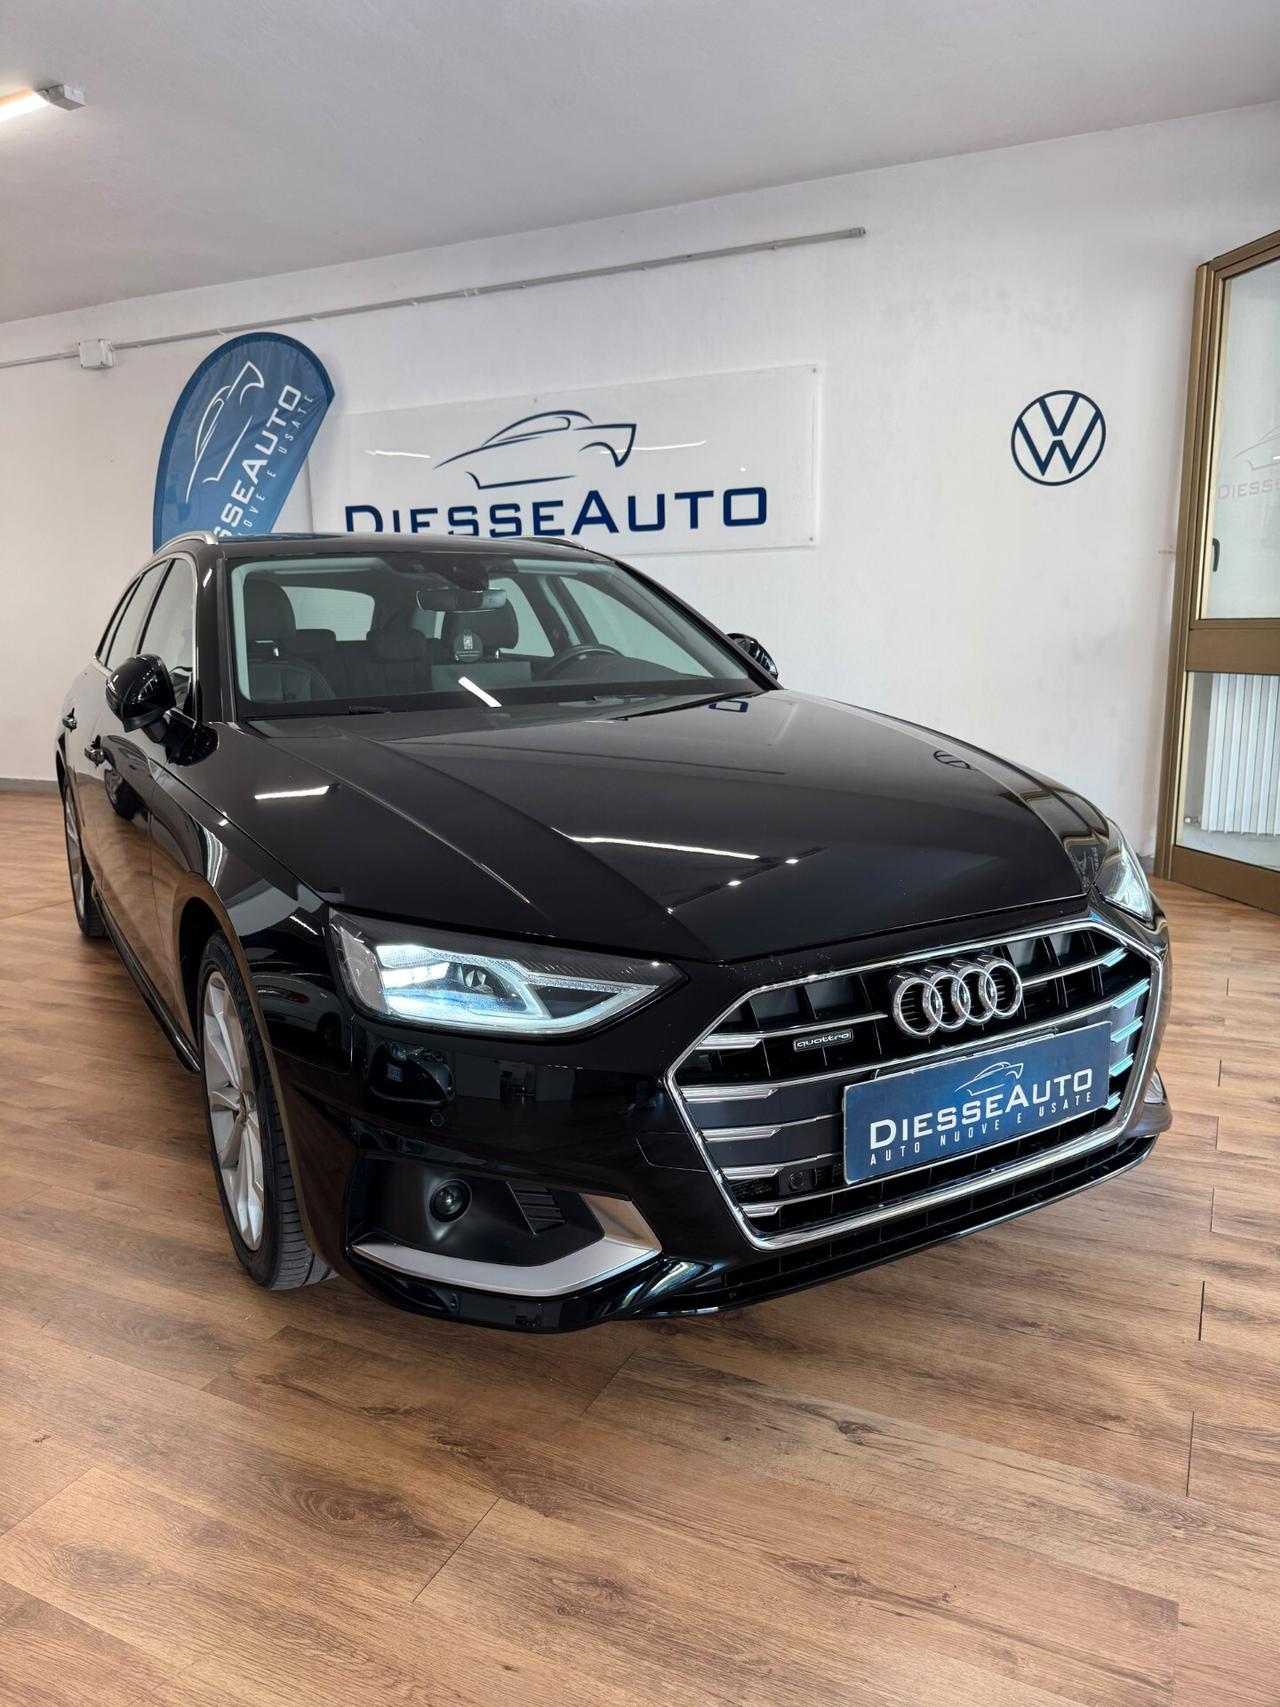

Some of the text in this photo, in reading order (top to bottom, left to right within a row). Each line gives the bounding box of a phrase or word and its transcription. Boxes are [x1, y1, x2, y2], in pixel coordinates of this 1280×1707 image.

[238, 394, 313, 535] OVE E USATE
[797, 1032, 849, 1048] quattro
[869, 1068, 1093, 1150] DIESSEAUTO
[870, 1091, 1093, 1166] AUTO NUOVE E USATE
